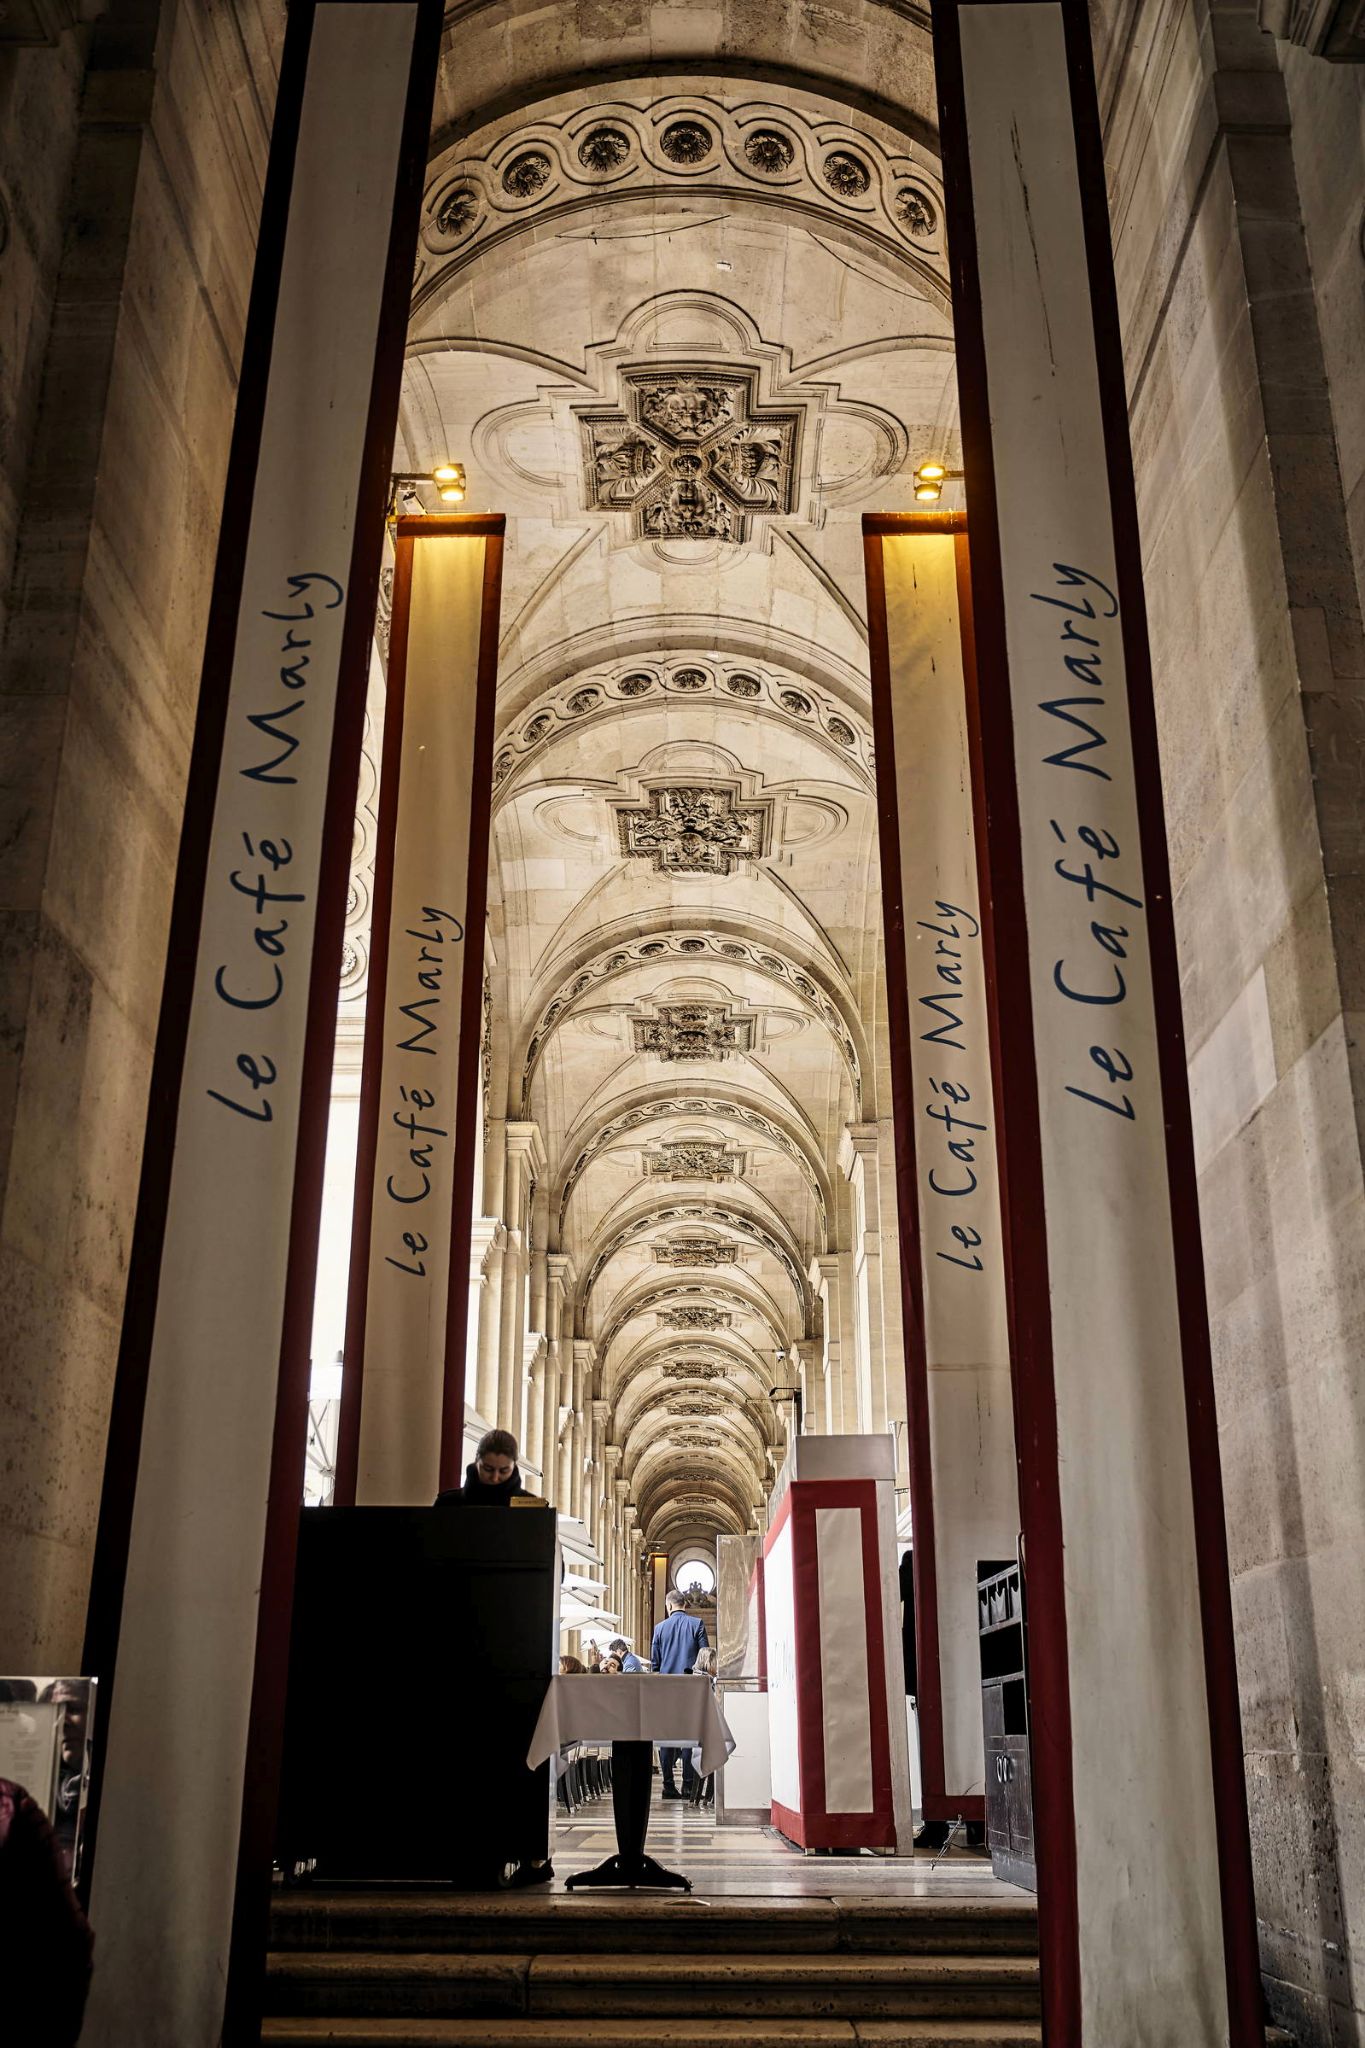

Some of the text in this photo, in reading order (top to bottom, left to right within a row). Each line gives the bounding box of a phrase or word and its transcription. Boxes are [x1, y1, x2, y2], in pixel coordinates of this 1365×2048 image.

[206, 572, 343, 1123] Le Café Marly
[1030, 562, 1143, 1121] Le Café Marly
[385, 906, 464, 1277] Le Café Marly
[917, 900, 987, 1272] Le Café Marly
